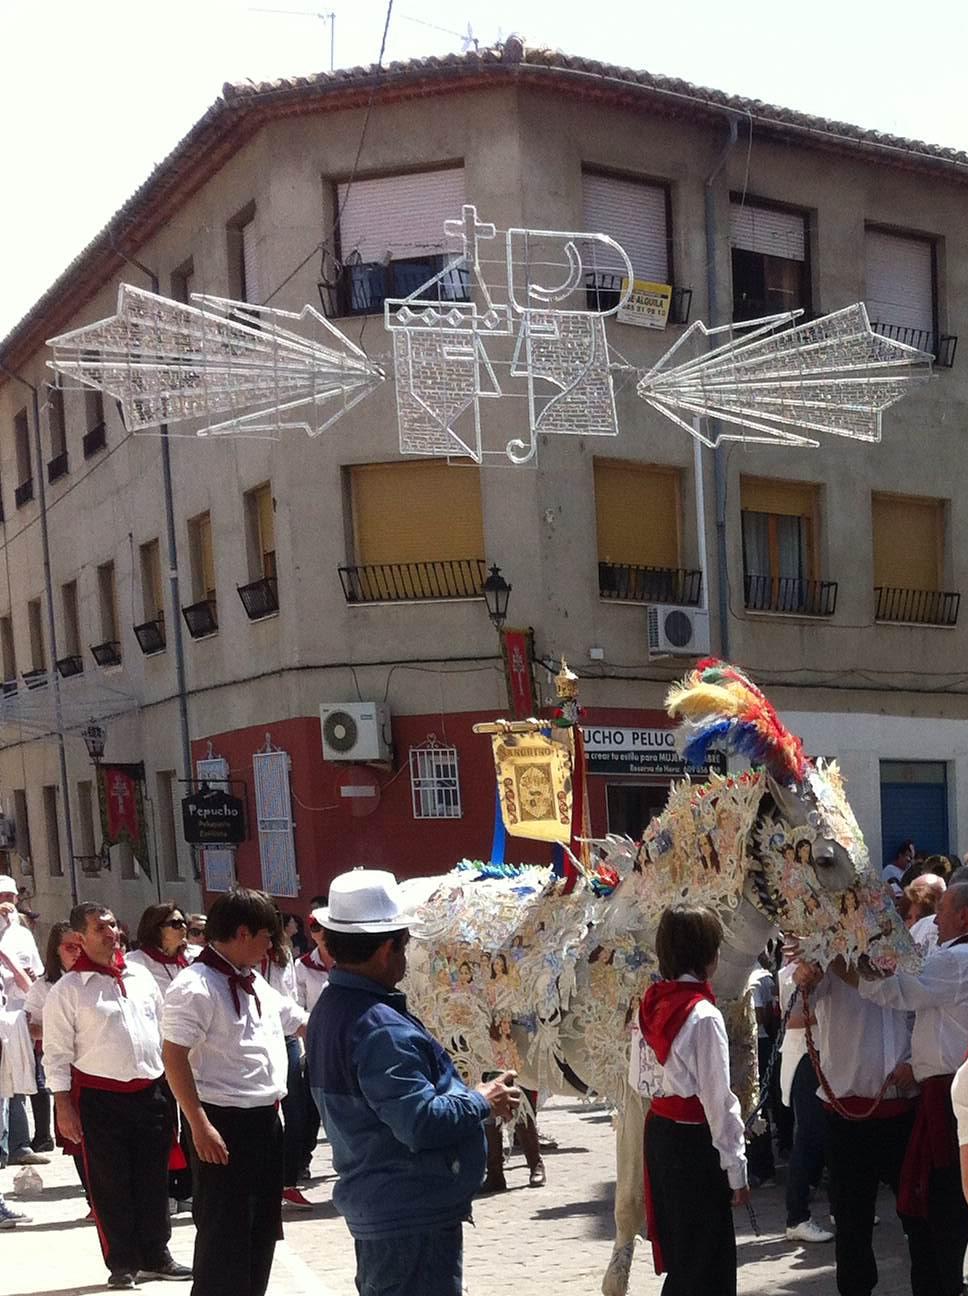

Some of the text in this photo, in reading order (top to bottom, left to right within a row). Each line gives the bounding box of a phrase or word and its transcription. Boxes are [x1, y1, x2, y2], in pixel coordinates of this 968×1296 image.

[583, 730, 676, 747] UCHO PELUQ
[188, 803, 239, 819] Pepucho
